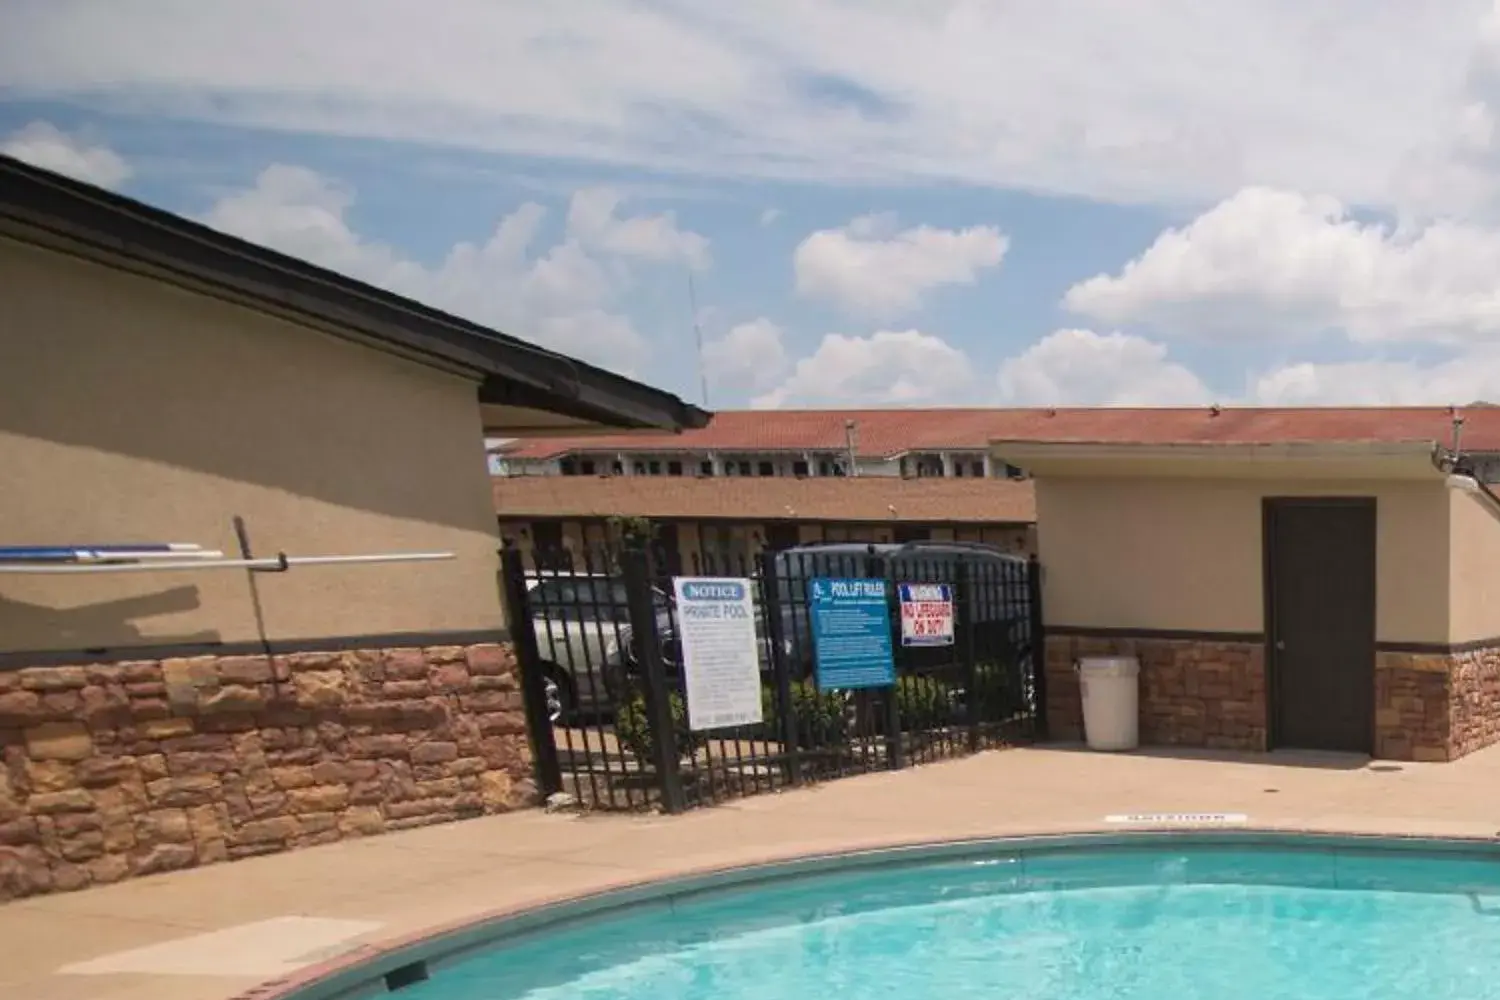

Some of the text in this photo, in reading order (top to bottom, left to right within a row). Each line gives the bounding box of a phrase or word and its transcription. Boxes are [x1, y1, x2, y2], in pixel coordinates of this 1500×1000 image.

[690, 585, 738, 597] NOTICE
[683, 603, 749, 618] PRIVATE POOL
[902, 603, 915, 618] NO
